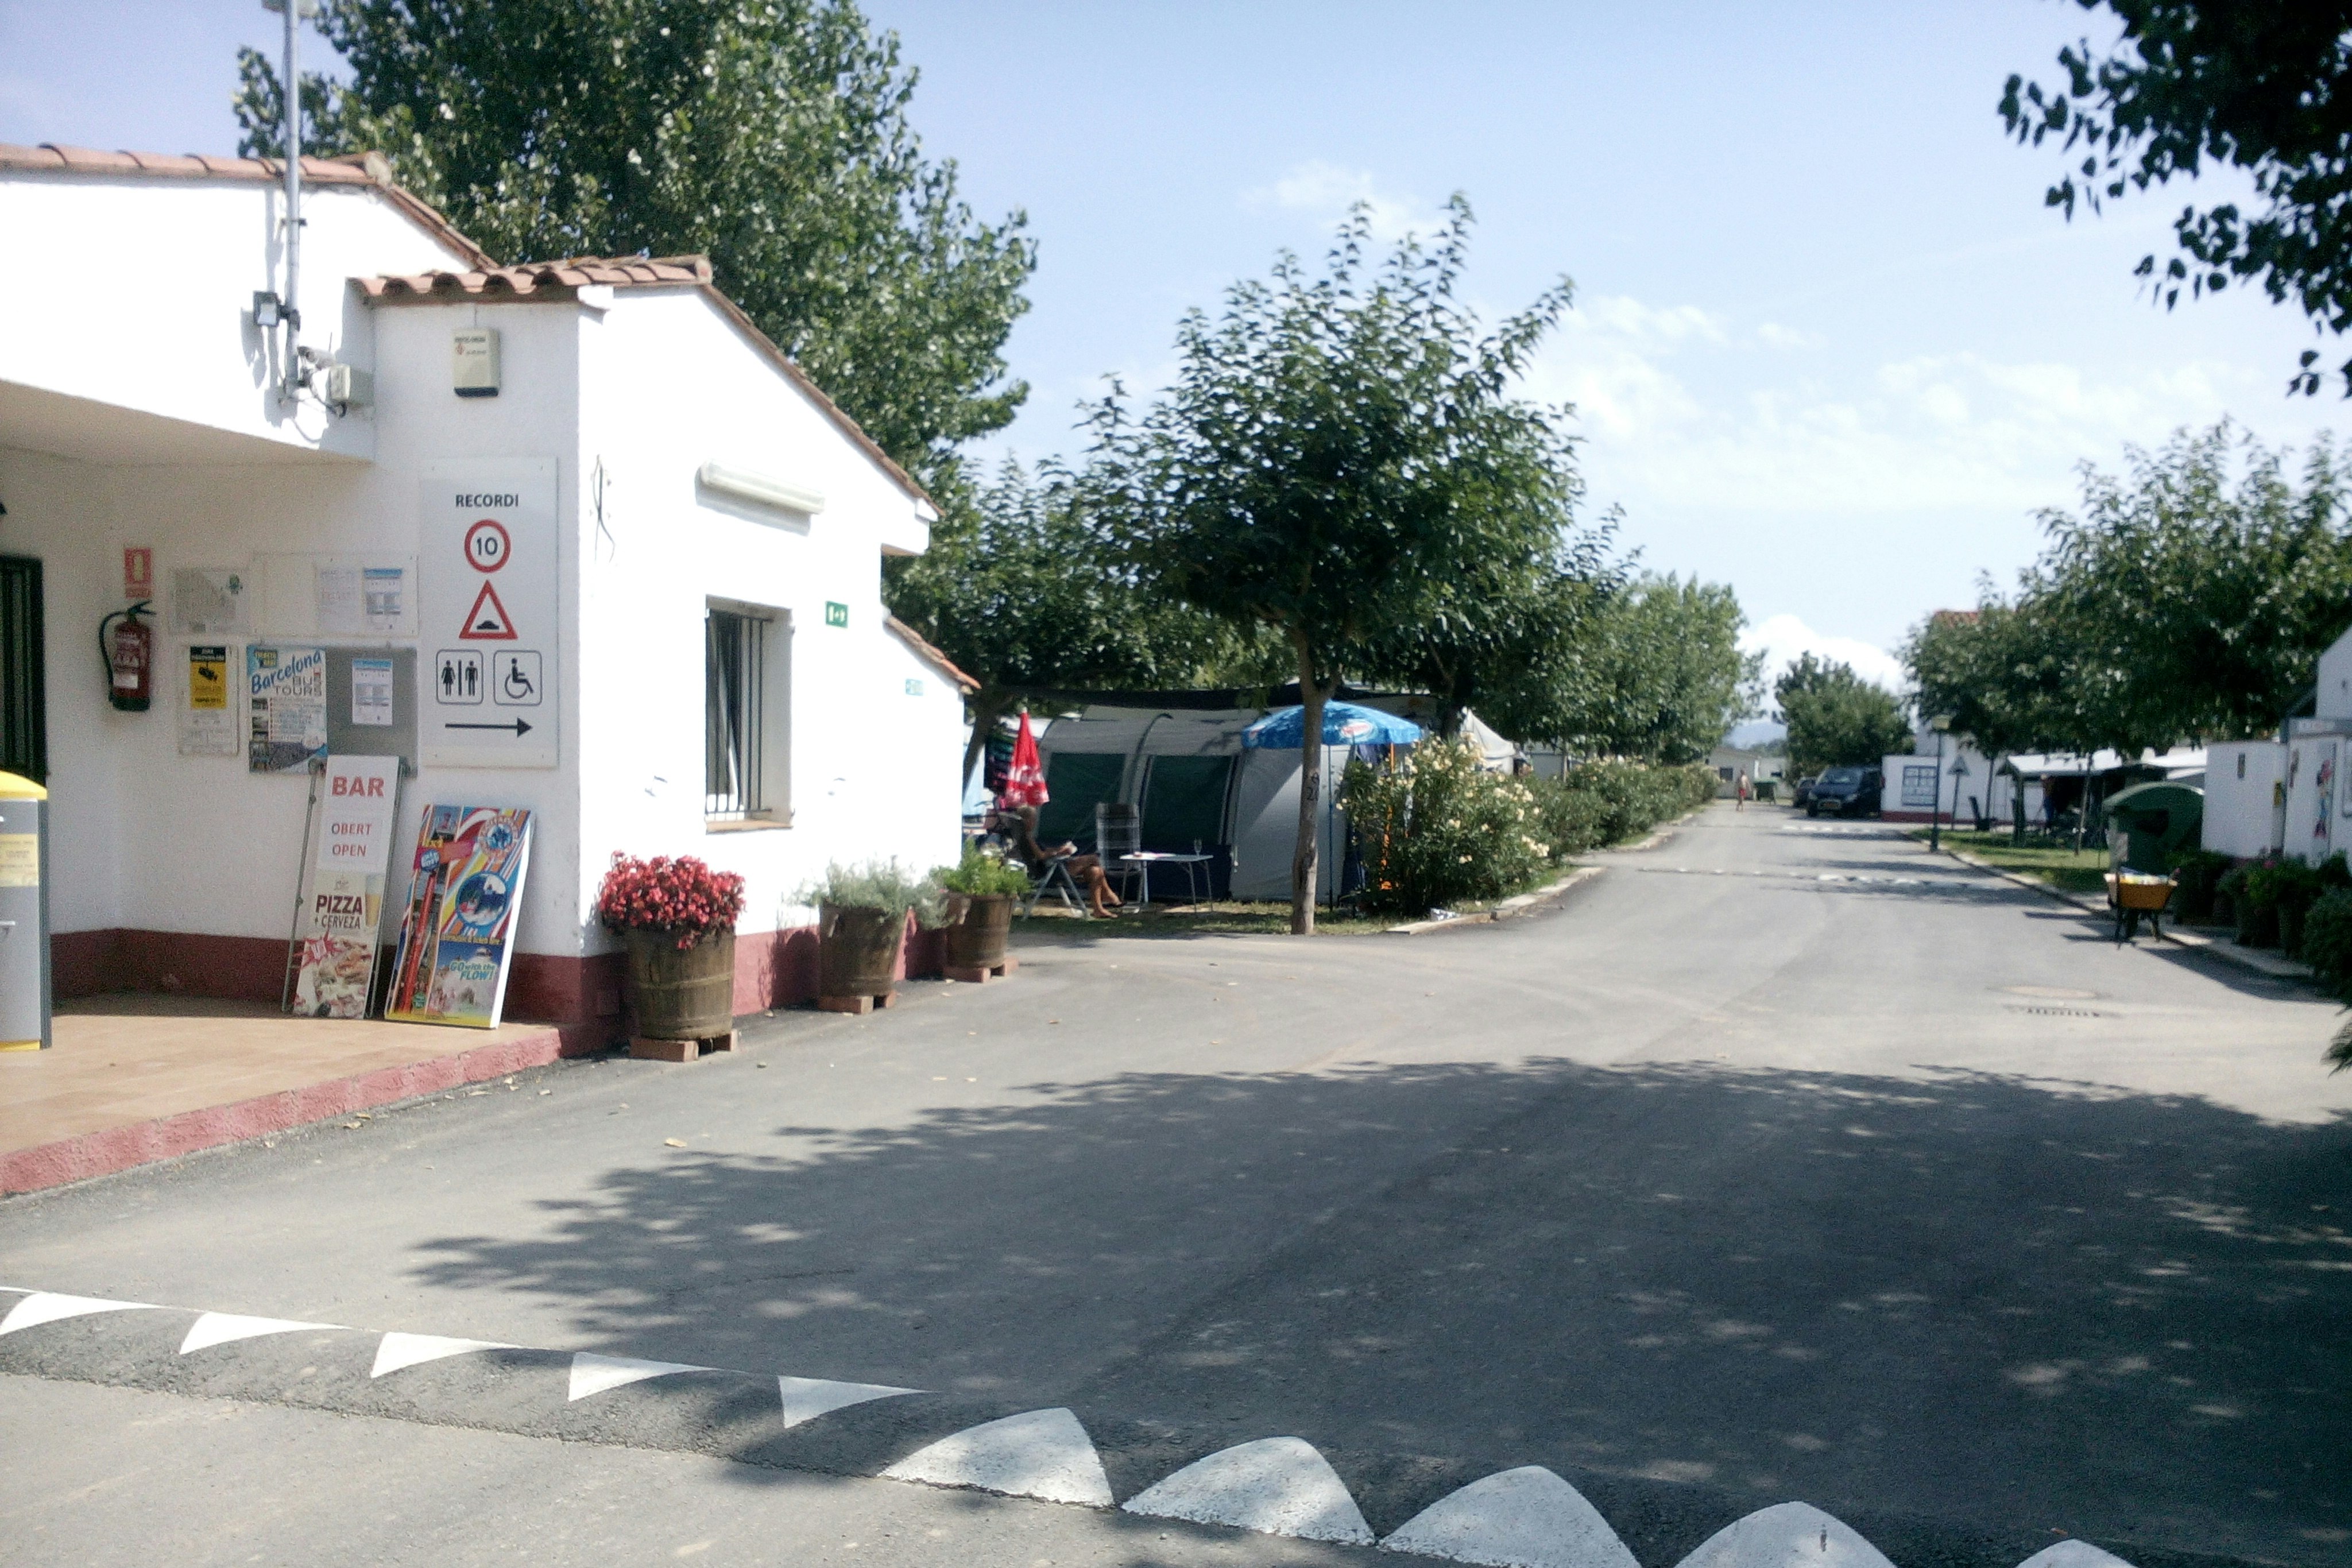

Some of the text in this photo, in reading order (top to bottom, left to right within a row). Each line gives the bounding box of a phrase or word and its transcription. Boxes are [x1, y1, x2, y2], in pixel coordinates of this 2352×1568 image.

[455, 494, 519, 507] RECORDI
[477, 537, 498, 555] 10
[252, 650, 322, 695] Barcelona
[276, 686, 322, 696] TOURS
[332, 776, 384, 797] BAR
[331, 823, 372, 835] OBERT
[332, 844, 366, 857] OPEN
[316, 895, 362, 915] PIZZA
[321, 915, 361, 929] CERVEZA
[450, 962, 465, 971] GO
[461, 970, 493, 981] FLOW!
